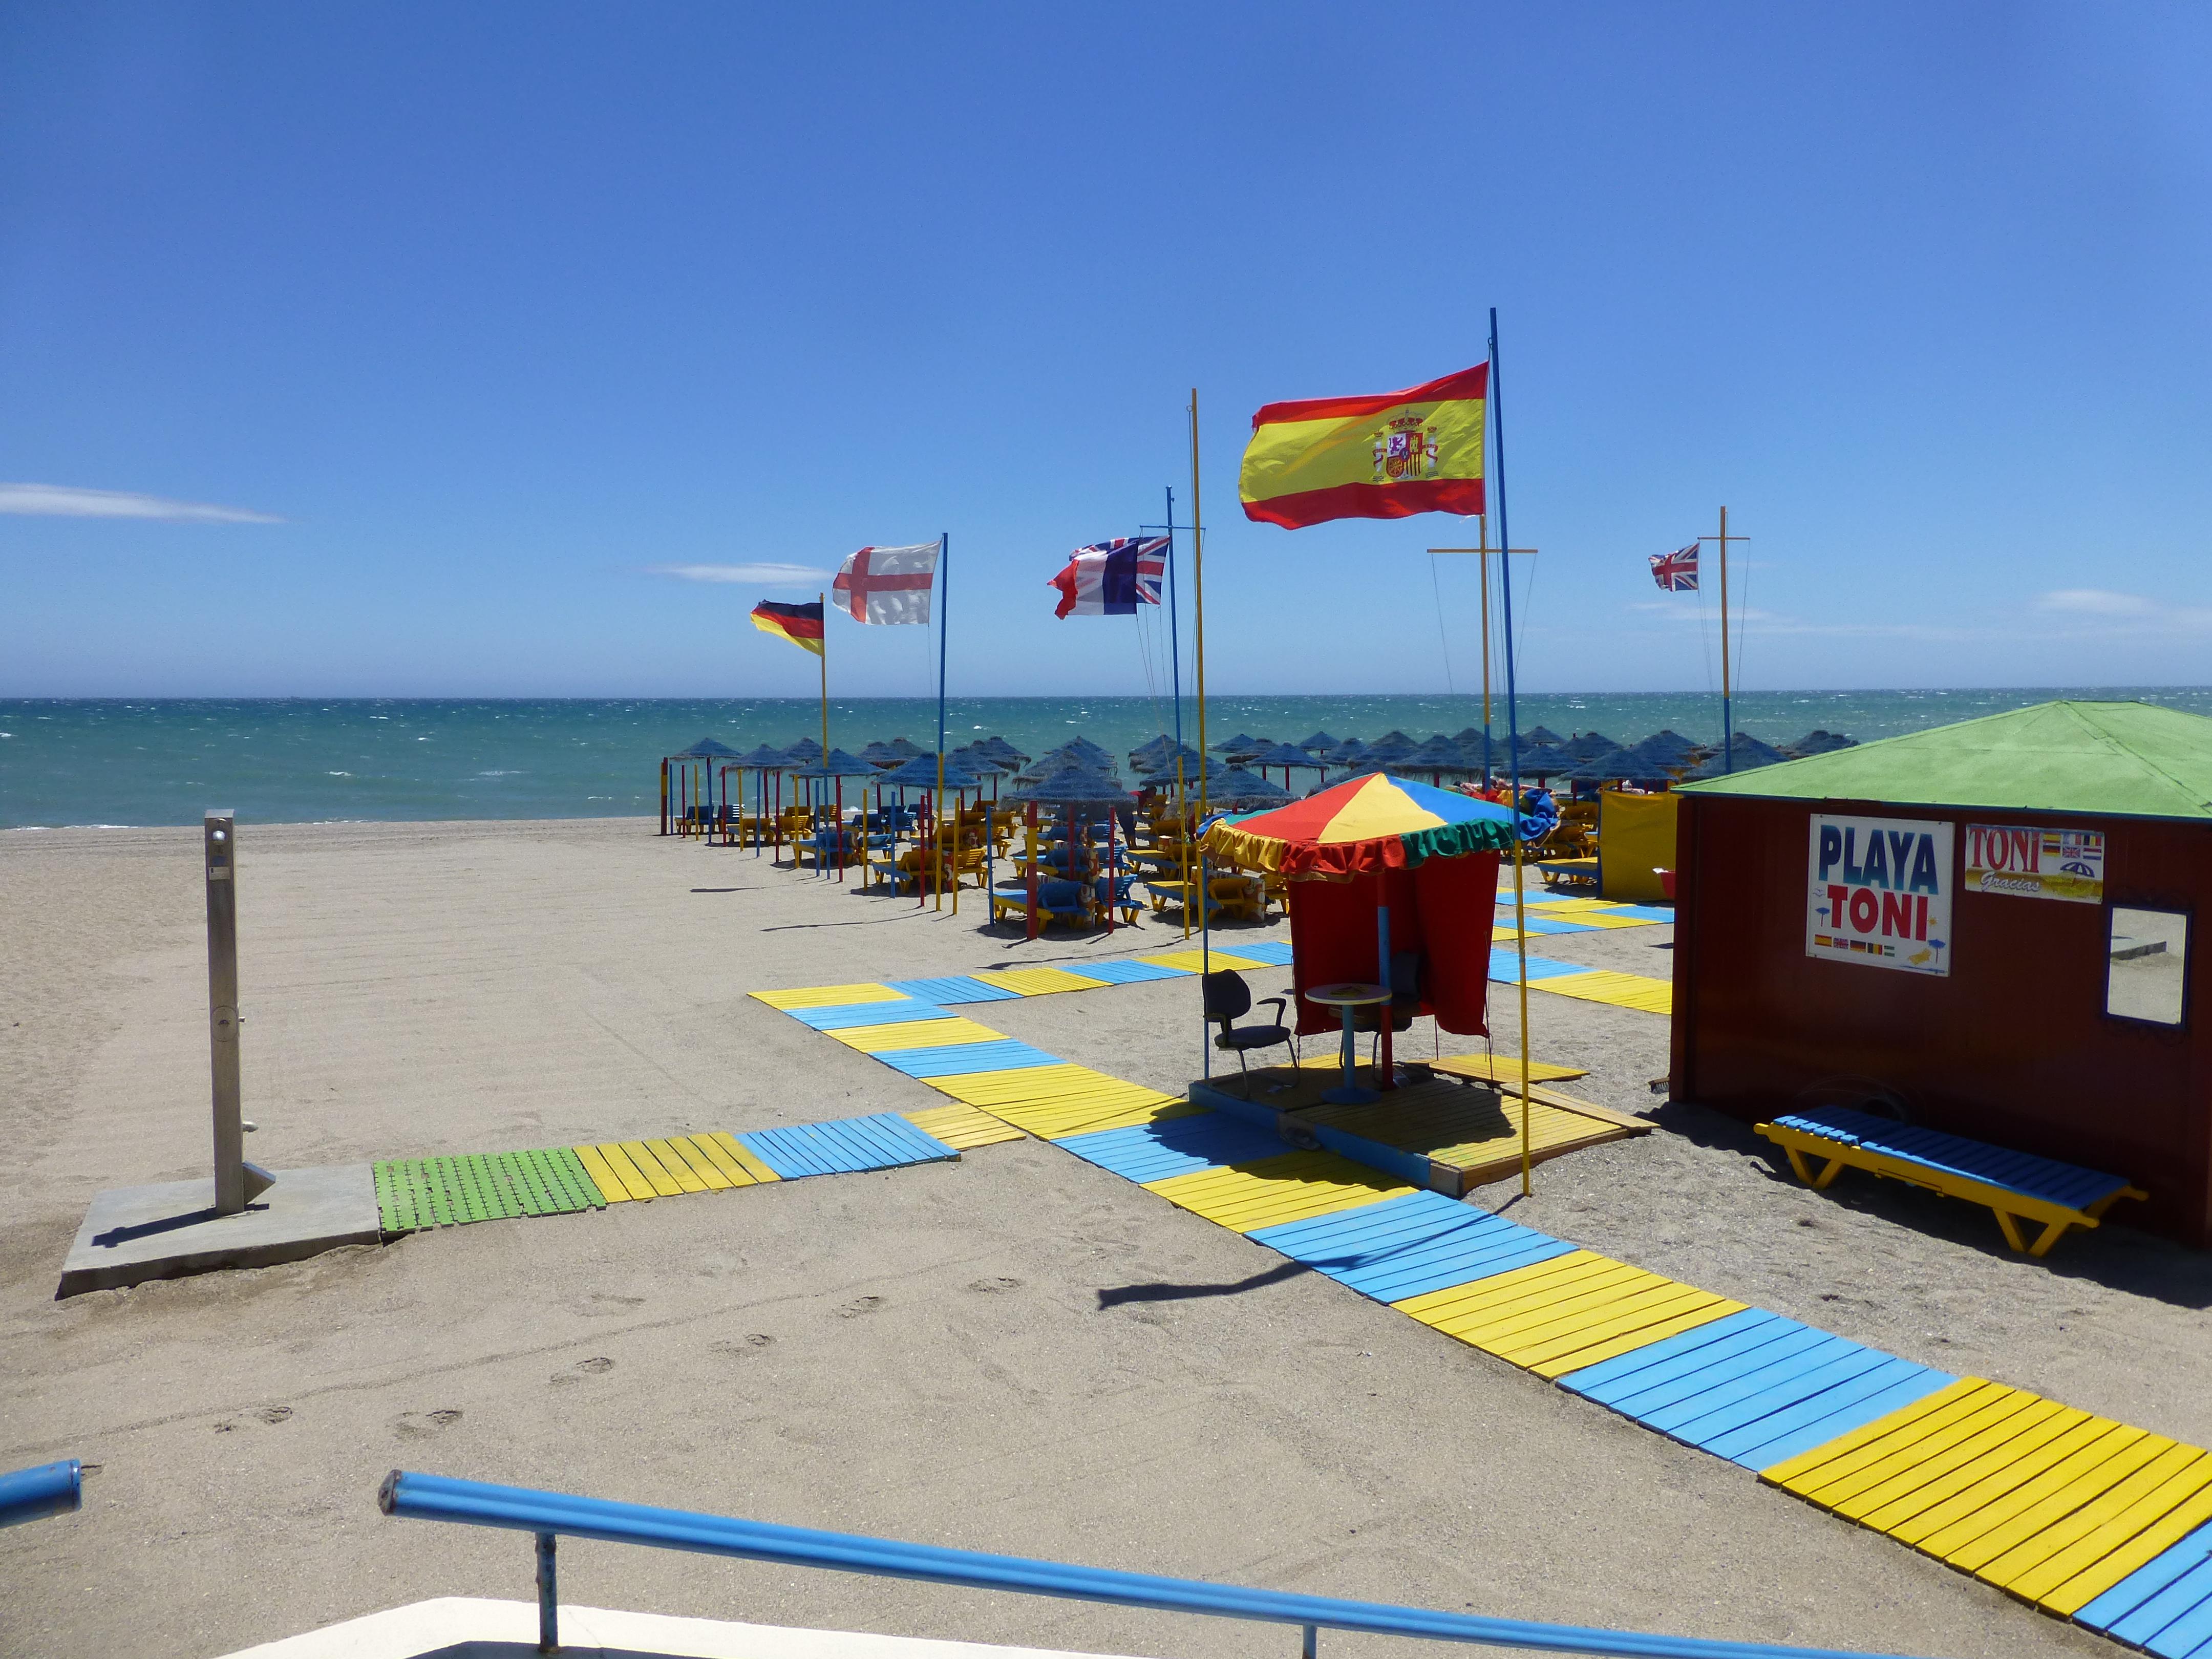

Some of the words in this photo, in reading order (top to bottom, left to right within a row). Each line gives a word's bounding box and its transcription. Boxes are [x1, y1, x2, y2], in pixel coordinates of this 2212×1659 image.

[1818, 824, 1939, 895] PLAYA
[1969, 827, 2040, 873] TONI
[1981, 871, 2040, 891] Gracias
[1827, 884, 1928, 942] TONI
